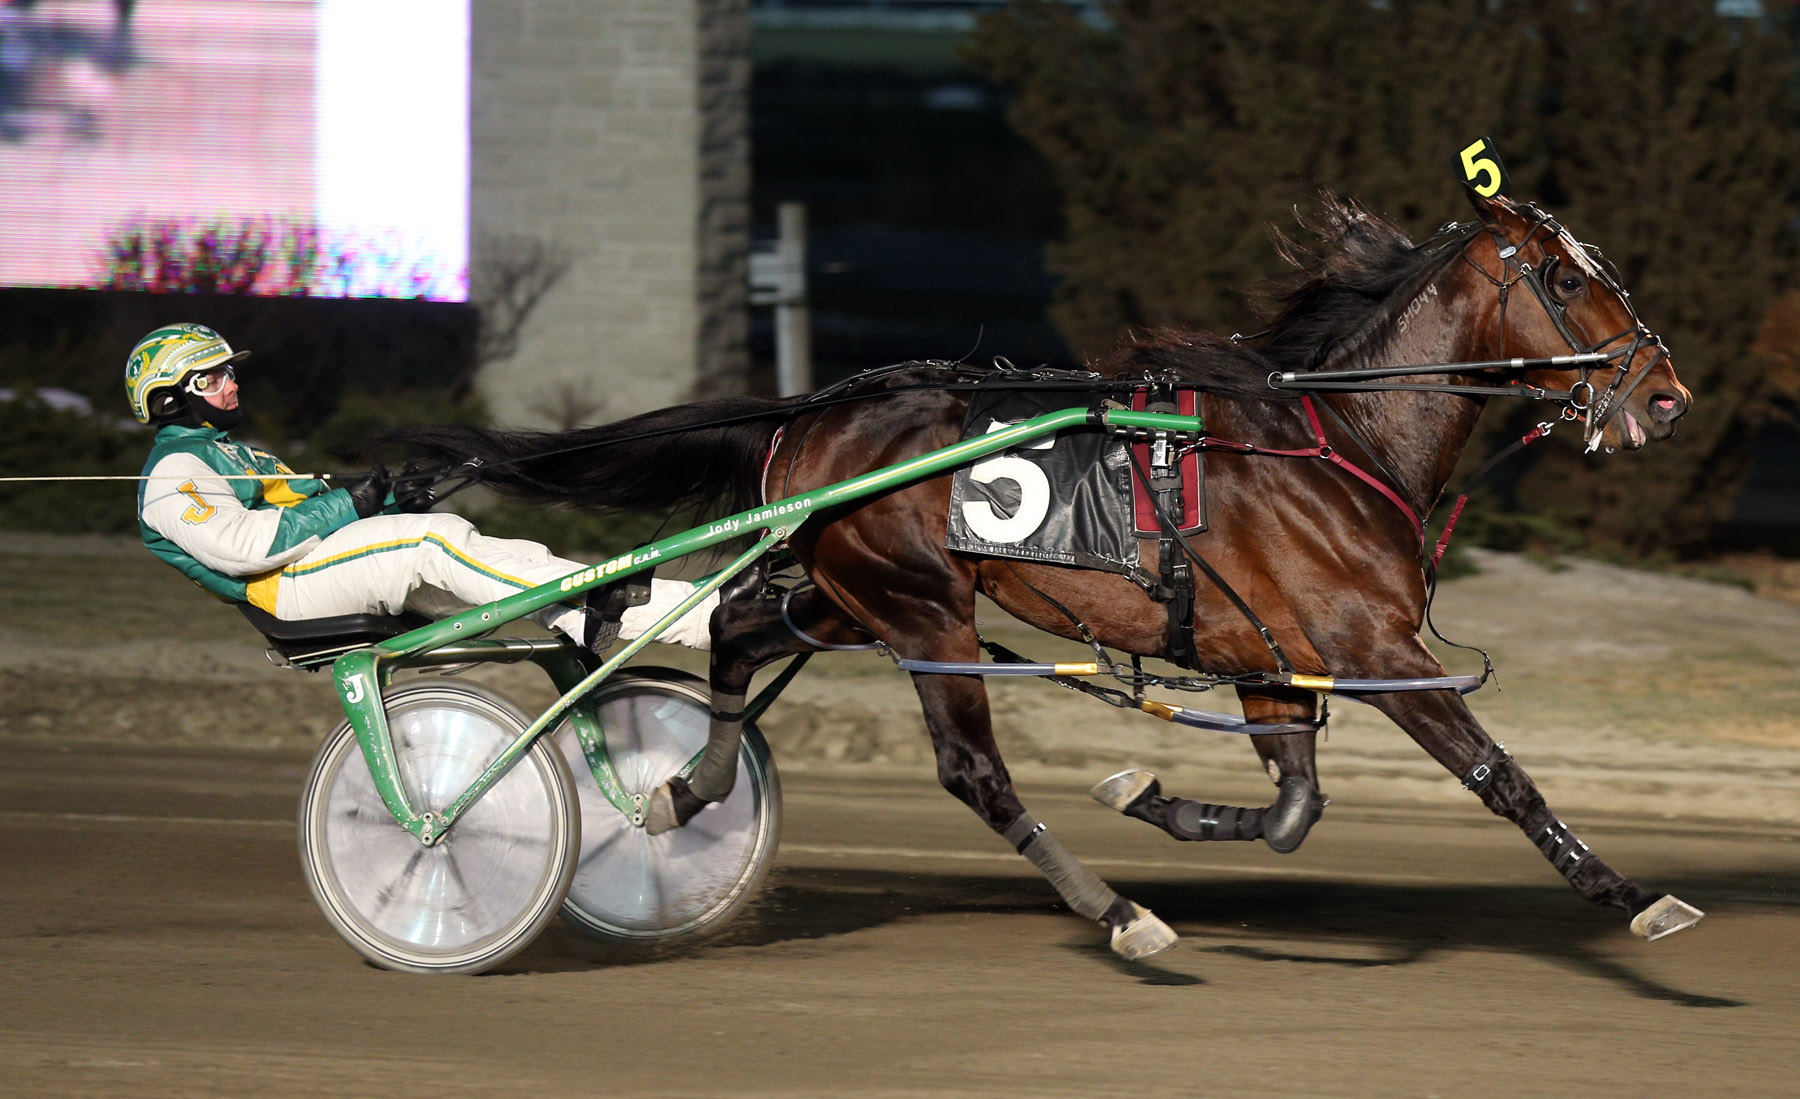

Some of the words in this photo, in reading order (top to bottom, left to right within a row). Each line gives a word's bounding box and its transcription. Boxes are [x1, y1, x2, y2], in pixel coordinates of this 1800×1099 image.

[1459, 138, 1502, 198] 5
[176, 479, 217, 525] J
[962, 419, 1057, 543] 5
[707, 518, 740, 537] Jody
[745, 497, 812, 525] Jamieson
[560, 553, 634, 592] CUSTOM
[344, 673, 364, 704] J
